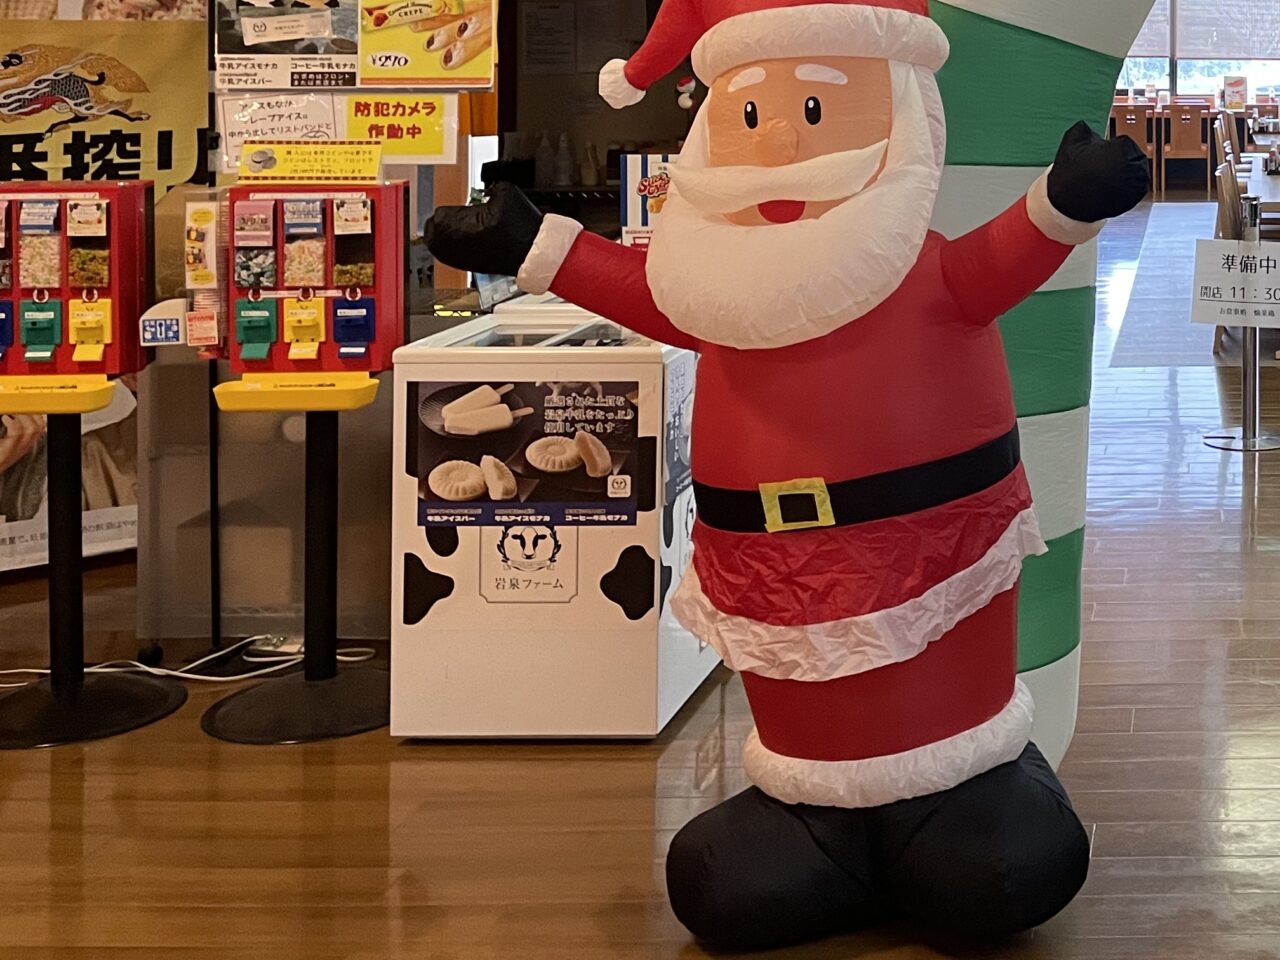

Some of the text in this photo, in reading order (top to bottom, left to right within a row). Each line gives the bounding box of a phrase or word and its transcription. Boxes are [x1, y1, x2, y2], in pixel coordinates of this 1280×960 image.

[354, 101, 437, 117] 防犯カメラ
[368, 123, 422, 139] 作動中
[1221, 253, 1277, 275] 準備中
[1200, 285, 1222, 299] 開店
[495, 577, 563, 590] 岩泉ファーム
